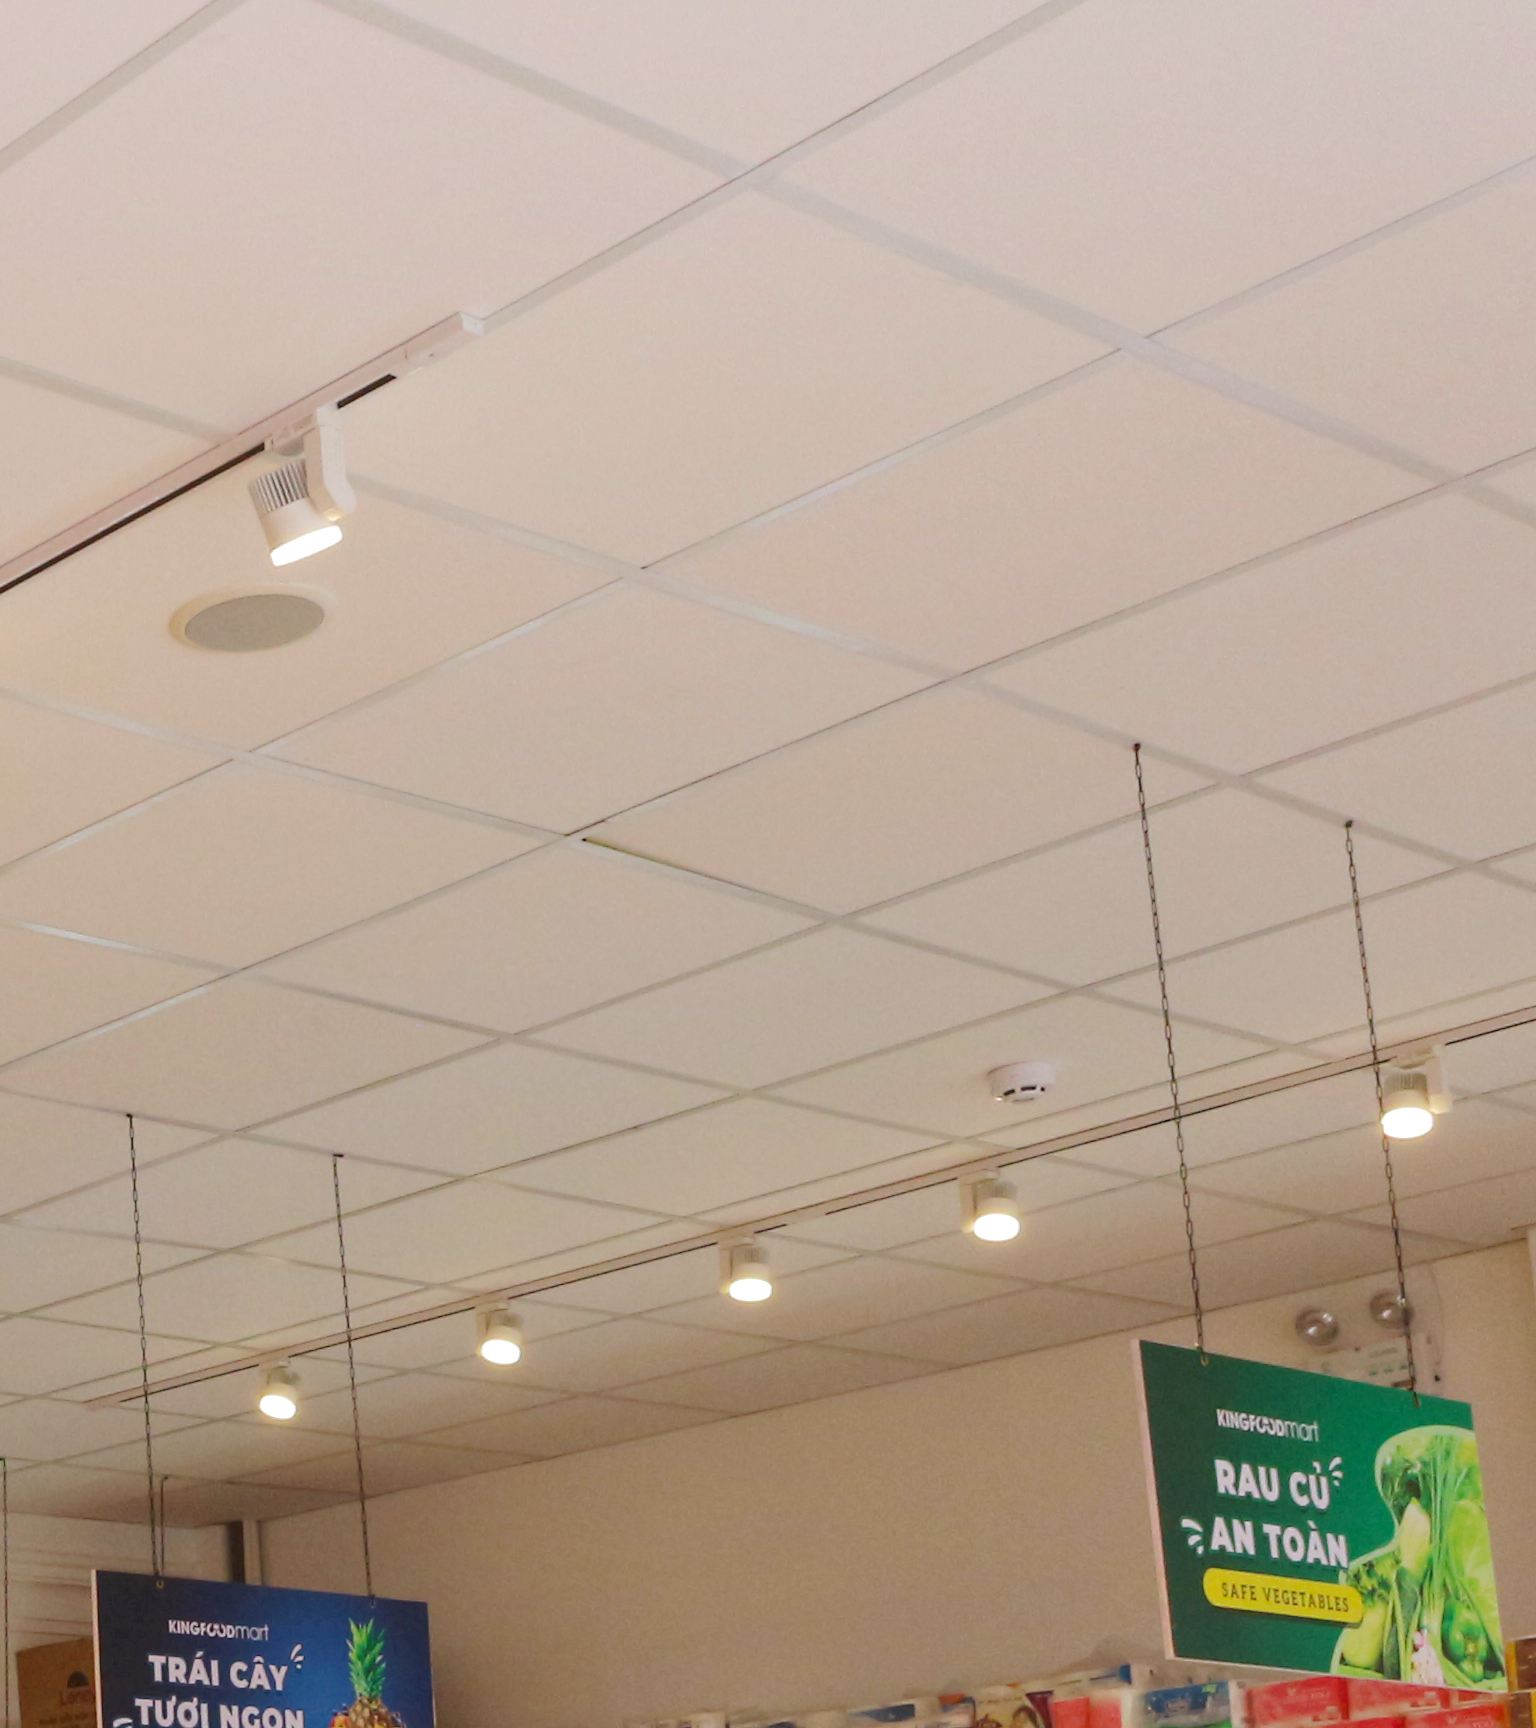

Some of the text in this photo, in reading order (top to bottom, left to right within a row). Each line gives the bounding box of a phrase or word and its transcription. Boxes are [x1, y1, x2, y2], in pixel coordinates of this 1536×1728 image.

[1214, 1459, 1330, 1511] RAU CỦ
[1211, 1516, 1348, 1569] AN TOÀN
[1221, 1581, 1349, 1613] SAFE VEGETABLES
[148, 1651, 289, 1691] TRÁI CÂY
